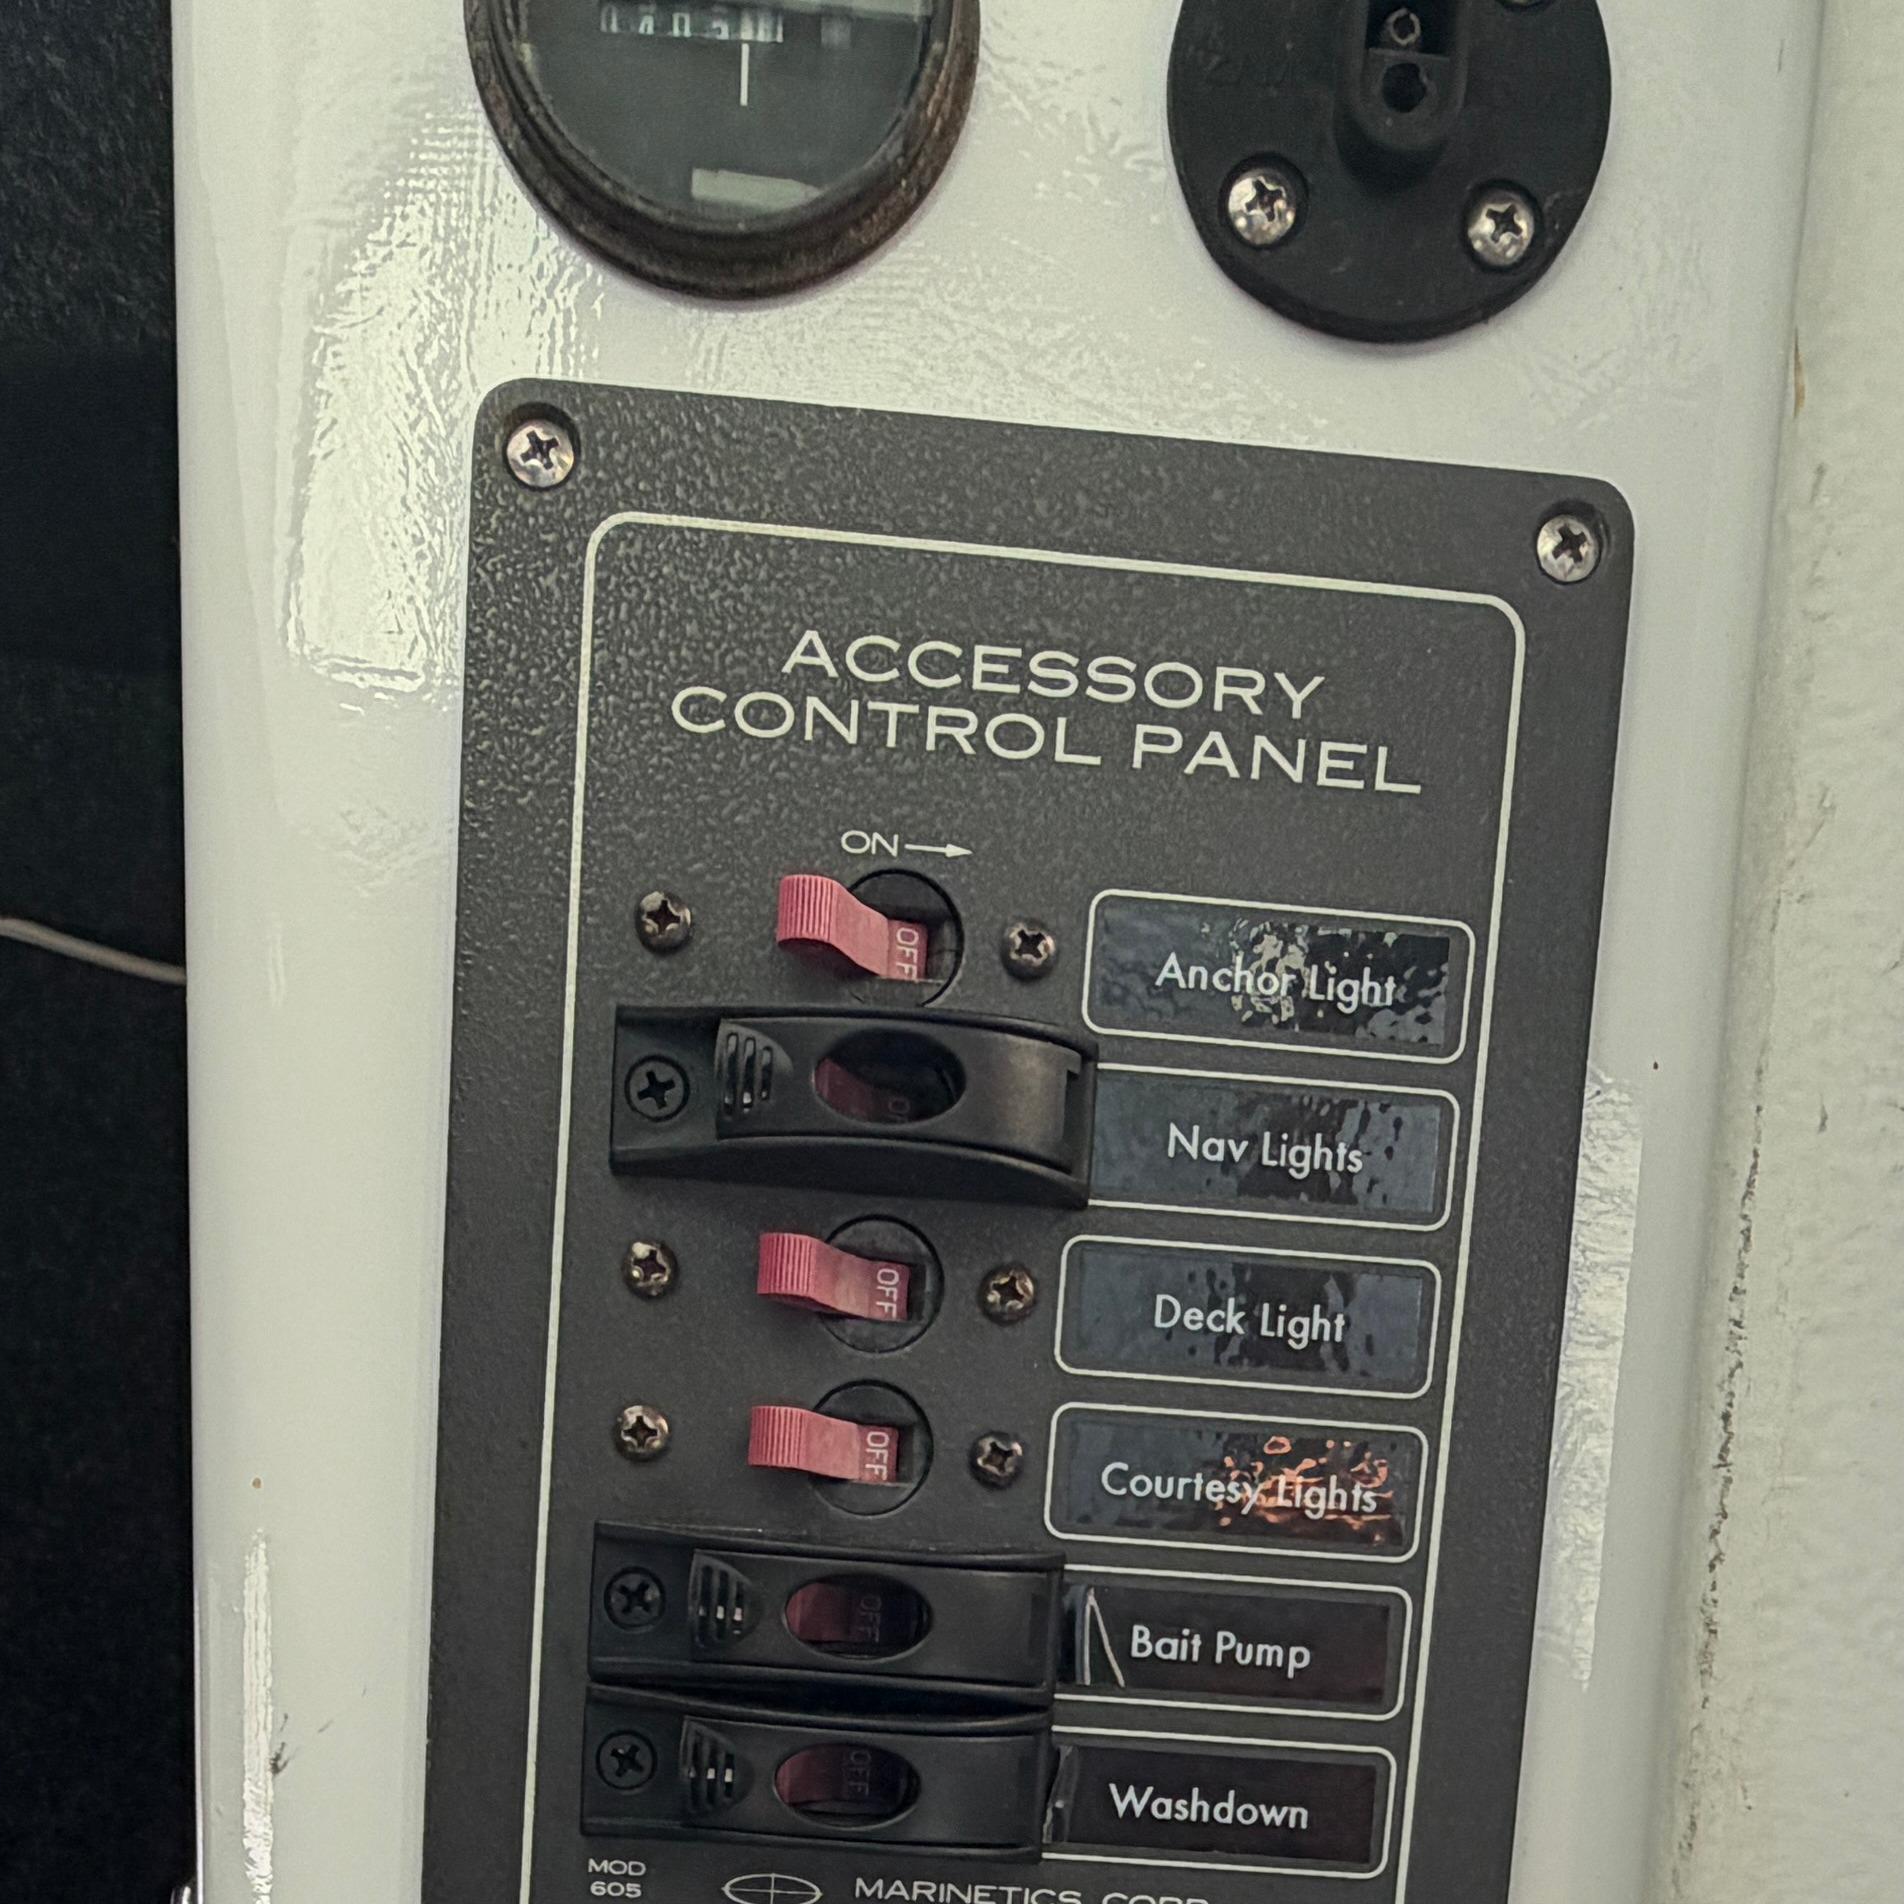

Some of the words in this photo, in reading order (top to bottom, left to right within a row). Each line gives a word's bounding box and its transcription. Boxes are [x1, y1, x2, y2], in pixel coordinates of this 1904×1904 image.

[782, 629, 1325, 719] ACCESSORY
[671, 686, 1102, 765] CONTROL
[1133, 724, 1421, 793] PANEL
[841, 831, 898, 856] ON
[895, 927, 920, 982] OFF
[1155, 953, 1292, 998] Anchor
[1310, 964, 1396, 1014] Light
[1168, 1123, 1248, 1161] Nav
[1263, 1132, 1362, 1178] Lights
[875, 1267, 900, 1319] OFF
[1155, 1295, 1245, 1334] Deck
[1261, 1303, 1345, 1349] Light
[865, 1430, 890, 1482] OFF
[1100, 1463, 1260, 1514] Courtesy
[1274, 1475, 1378, 1522] Lights
[1132, 1625, 1201, 1661] Bait
[1216, 1631, 1310, 1678] Pump
[1110, 1784, 1307, 1829] Washdown
[589, 1859, 645, 1875] MOD
[591, 1881, 641, 1897] 605
